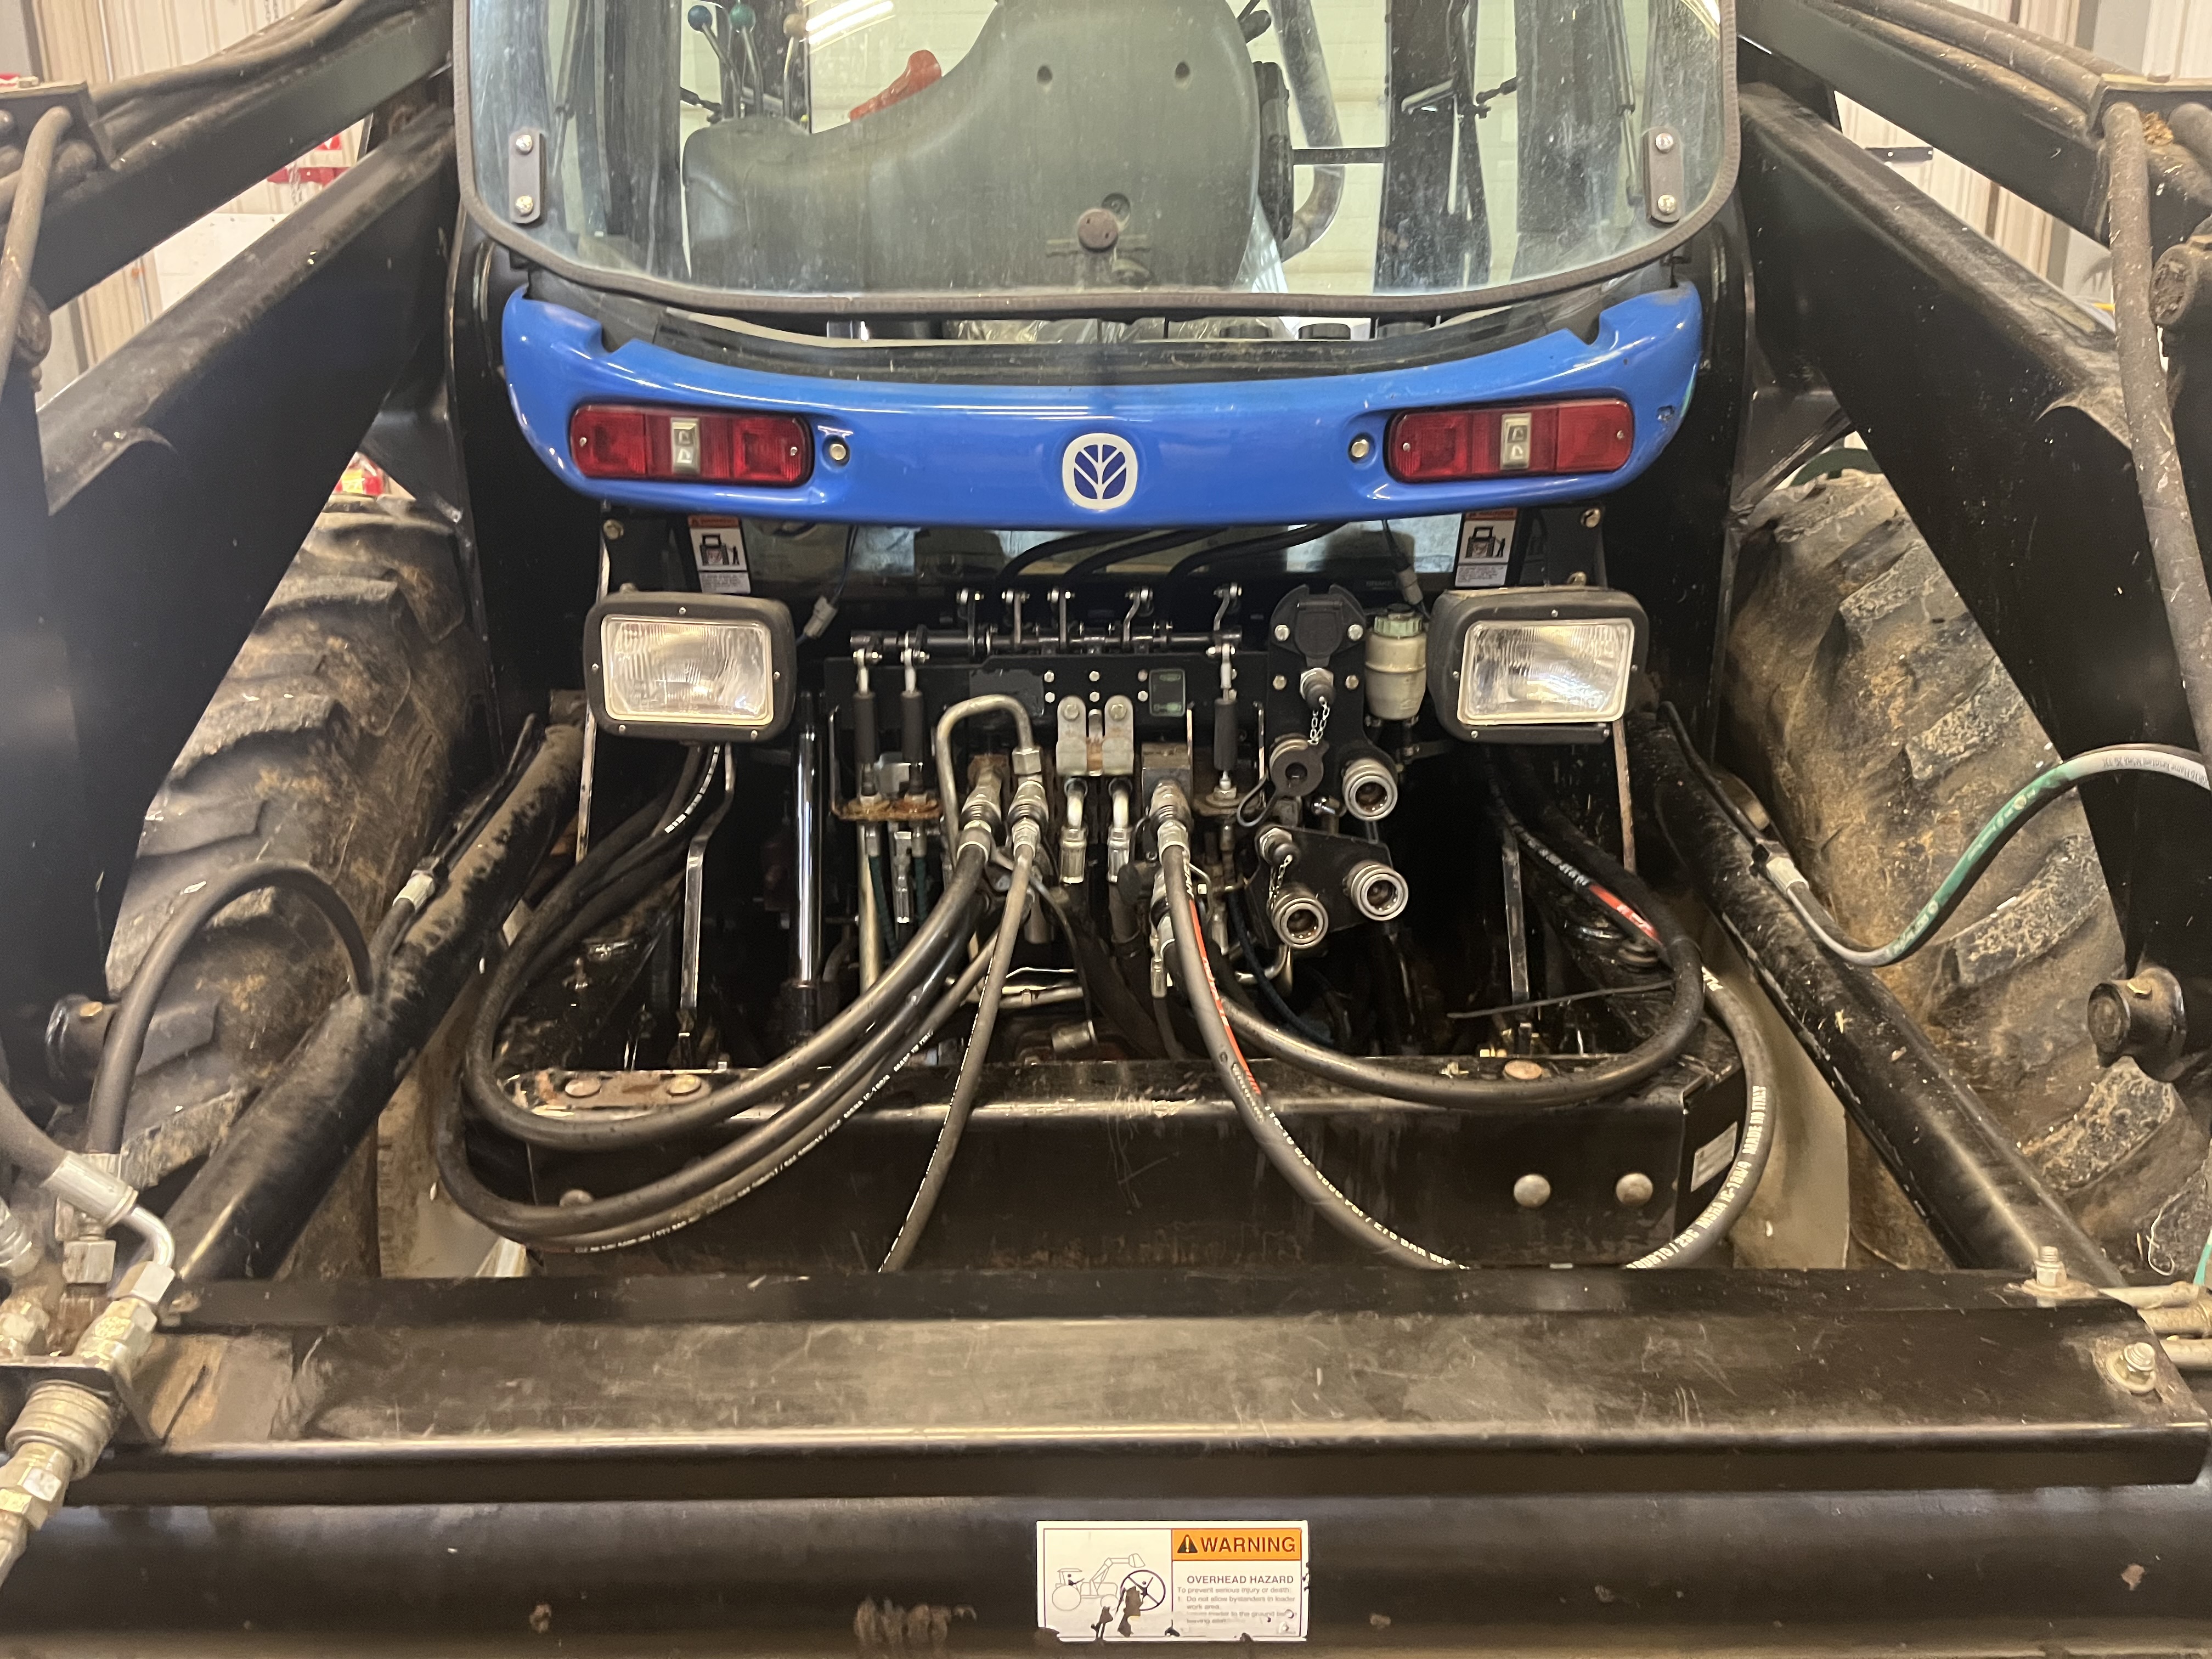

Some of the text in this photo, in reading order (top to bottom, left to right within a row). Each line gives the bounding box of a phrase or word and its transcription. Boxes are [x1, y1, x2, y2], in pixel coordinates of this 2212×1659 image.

[1751, 1085, 1766, 1110] ITALY
[1750, 1111, 1765, 1124] IN
[1742, 1125, 1763, 1154] MADE
[1344, 1199, 1363, 1217] PSI
[1400, 1238, 1426, 1256] BAR
[1200, 1536, 1295, 1553] WARNING
[1187, 1575, 1294, 1584] OVERHEAD HAZARD
